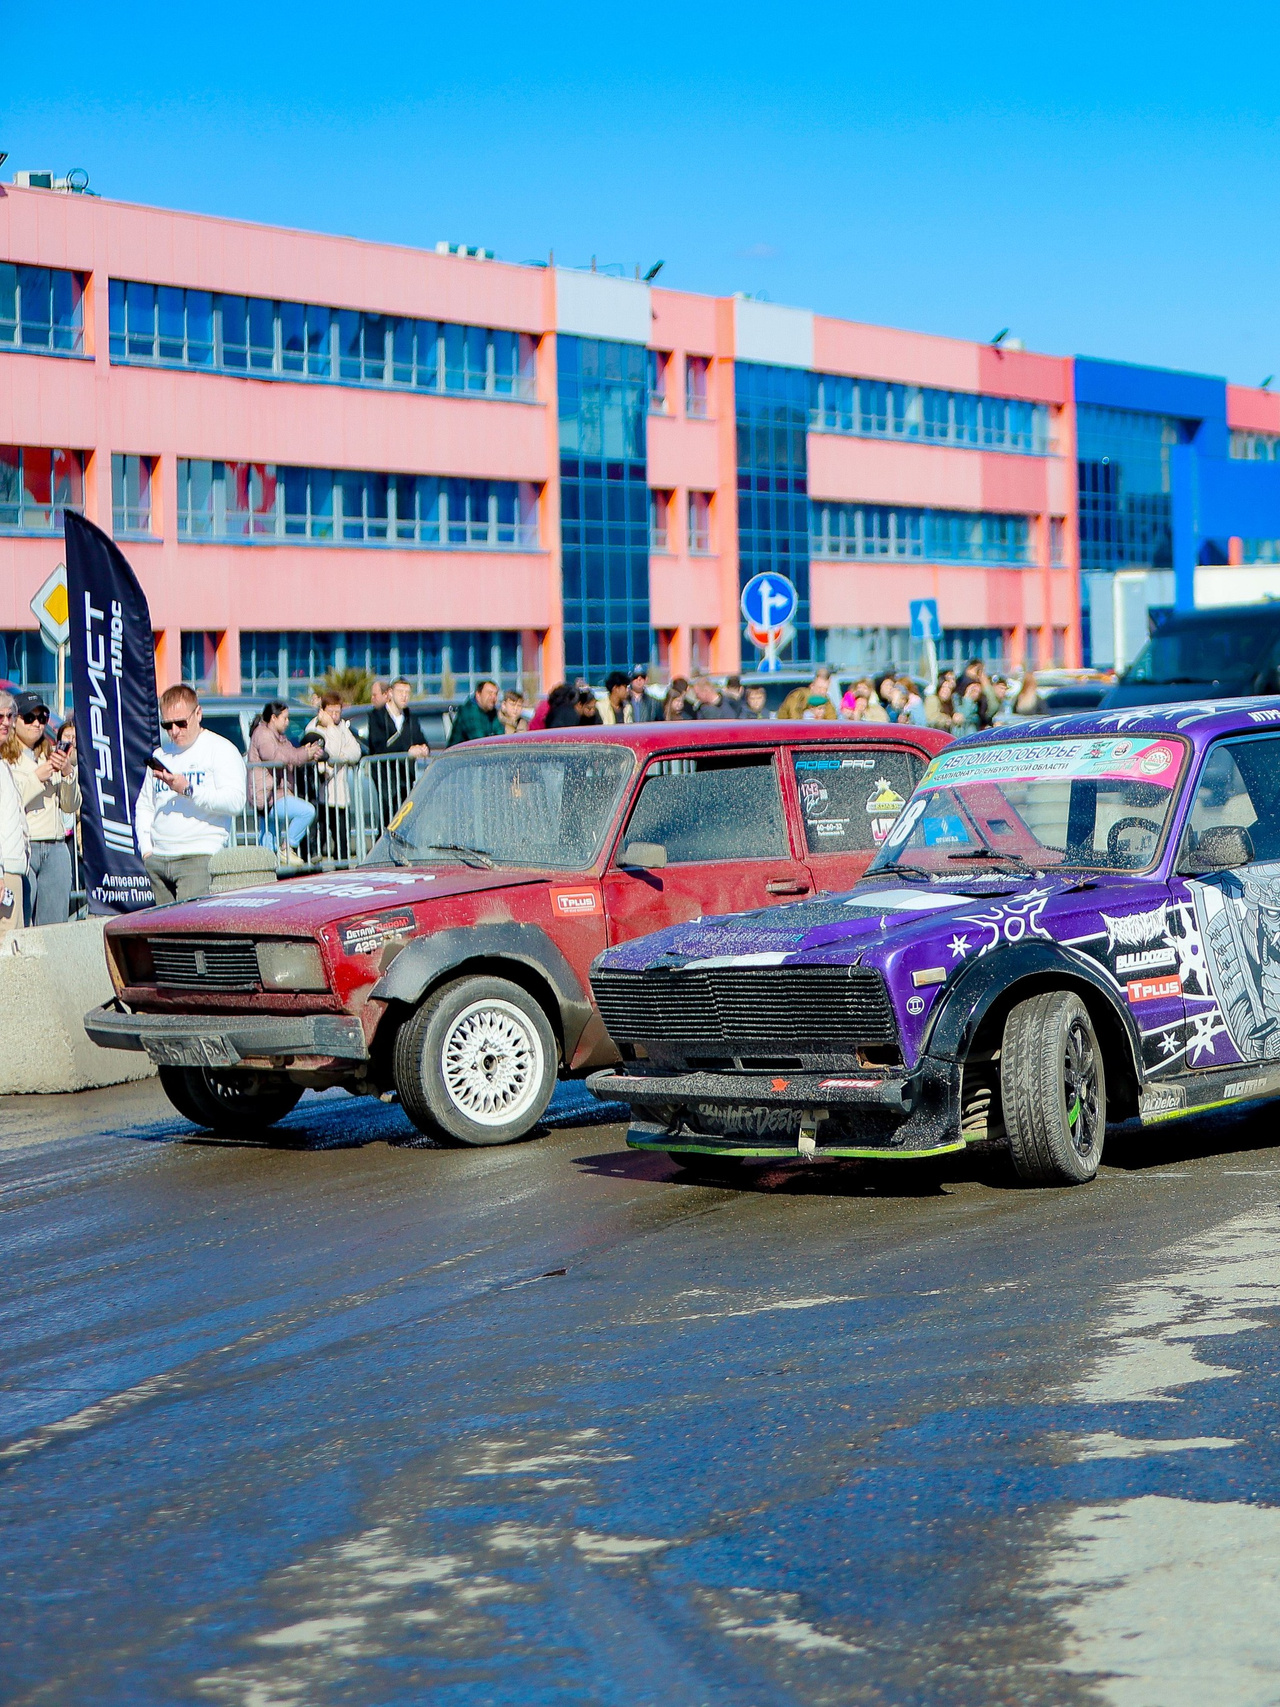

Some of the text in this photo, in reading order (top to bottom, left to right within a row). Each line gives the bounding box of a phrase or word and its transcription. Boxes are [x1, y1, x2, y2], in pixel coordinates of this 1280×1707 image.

[85, 591, 116, 815] ТУРИСТ
[796, 760, 875, 770] ADEO.PRO
[939, 744, 1081, 770] АВТОМНОГОБОРЬЕ
[933, 763, 1069, 782] ЧЕМПИОНАТ ОРЕНБУРГСКОЙ ОБЛАСТИ
[560, 898, 593, 906] TPLUS
[1116, 947, 1176, 968] BULLDOZER
[1130, 982, 1180, 999] TPLUS
